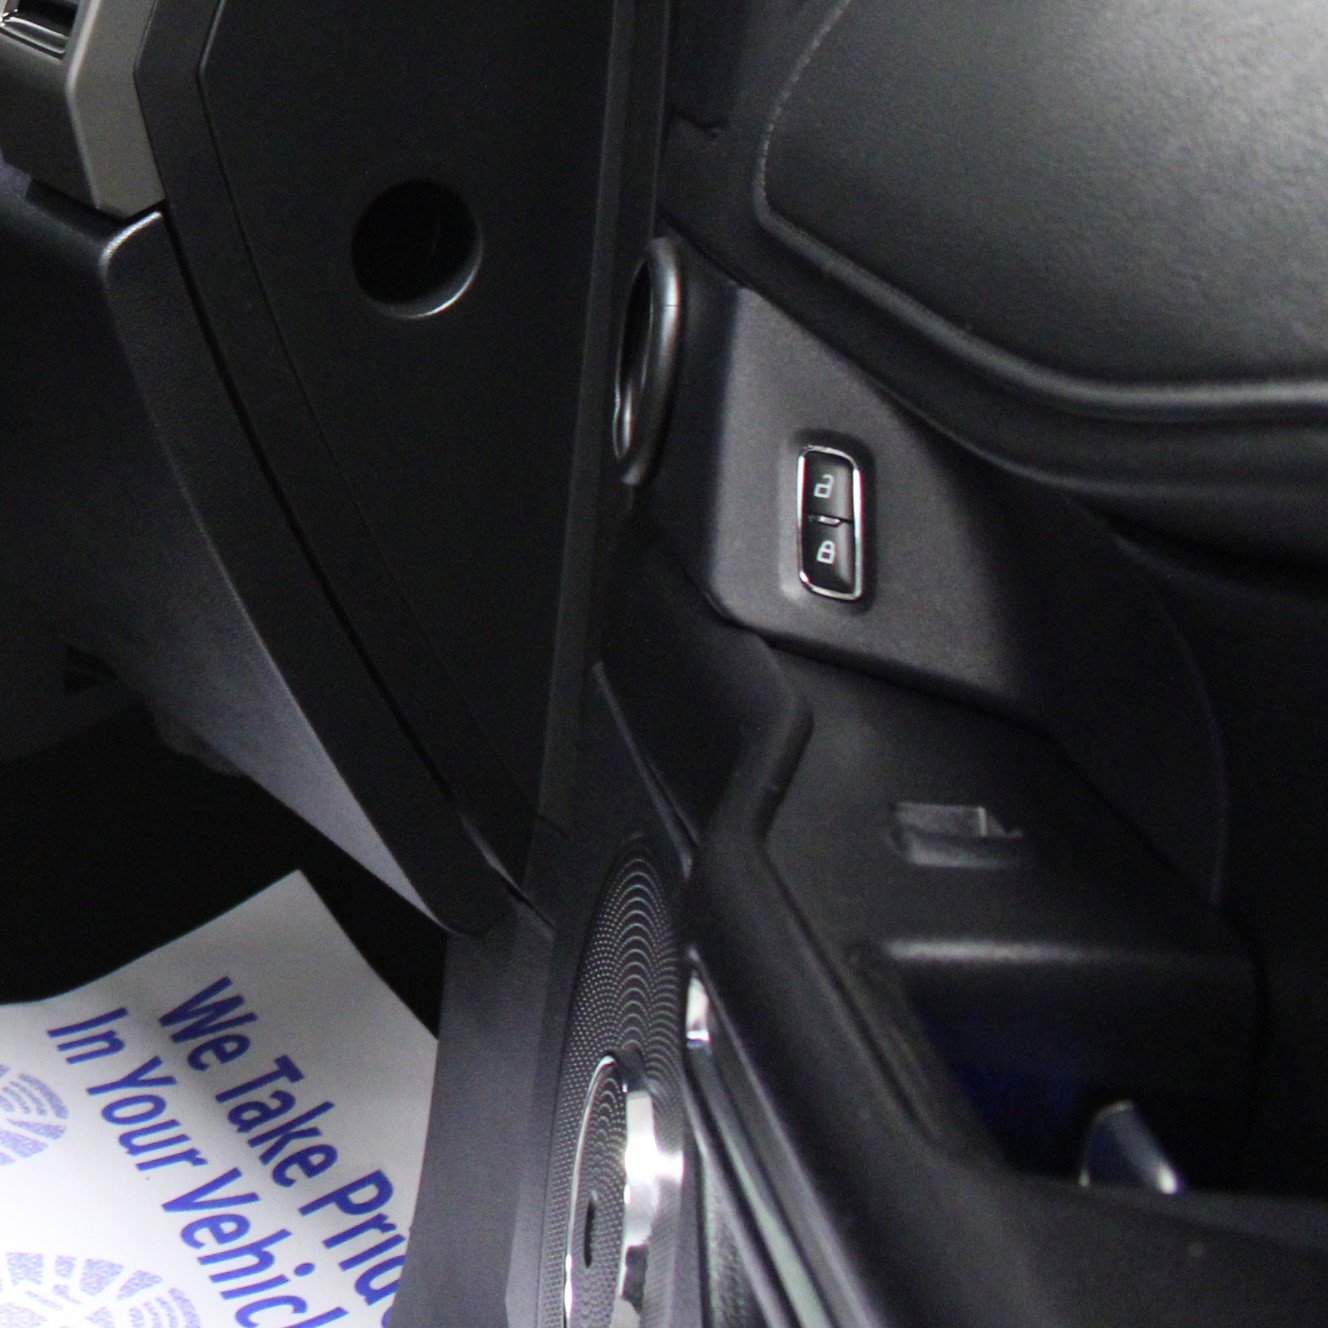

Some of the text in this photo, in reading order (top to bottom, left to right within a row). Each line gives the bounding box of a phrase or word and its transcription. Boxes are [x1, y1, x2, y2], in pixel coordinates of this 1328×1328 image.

[47, 1007, 129, 1065] In
[86, 1055, 208, 1171] Your
[159, 976, 407, 1328] We Take Prid
